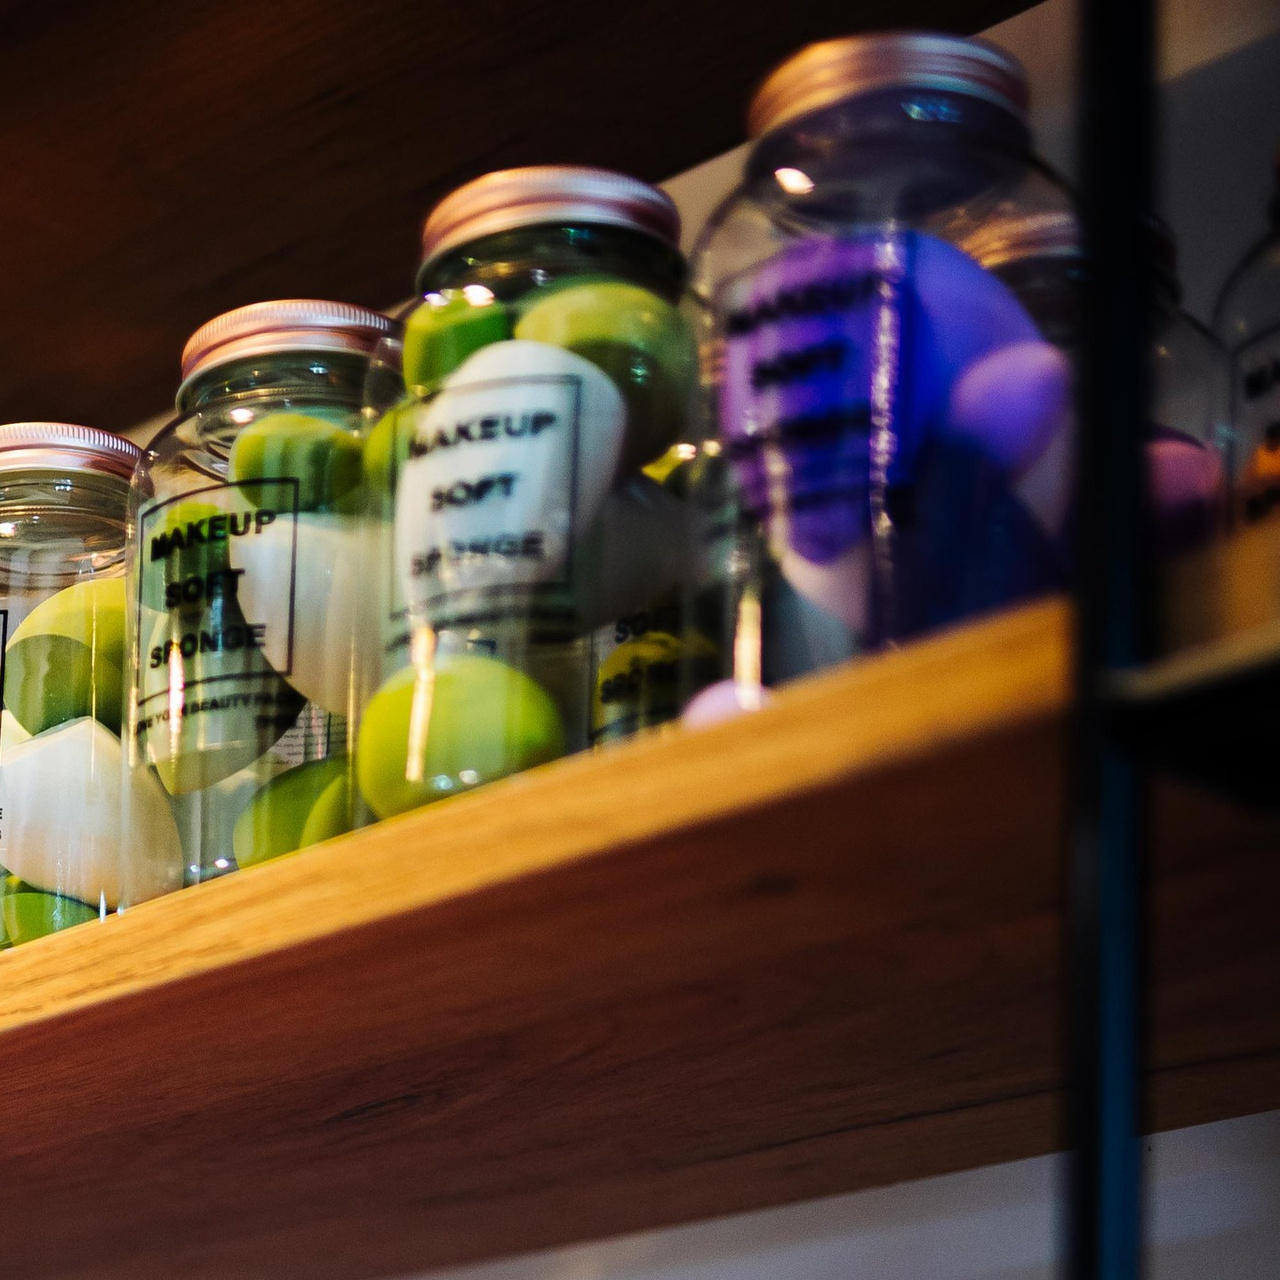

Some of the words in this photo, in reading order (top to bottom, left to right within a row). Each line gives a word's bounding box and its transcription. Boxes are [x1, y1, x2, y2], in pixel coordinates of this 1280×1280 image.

[150, 508, 277, 562] MAKEUP
[165, 568, 245, 608] SOFT
[150, 622, 267, 670] SPONGE
